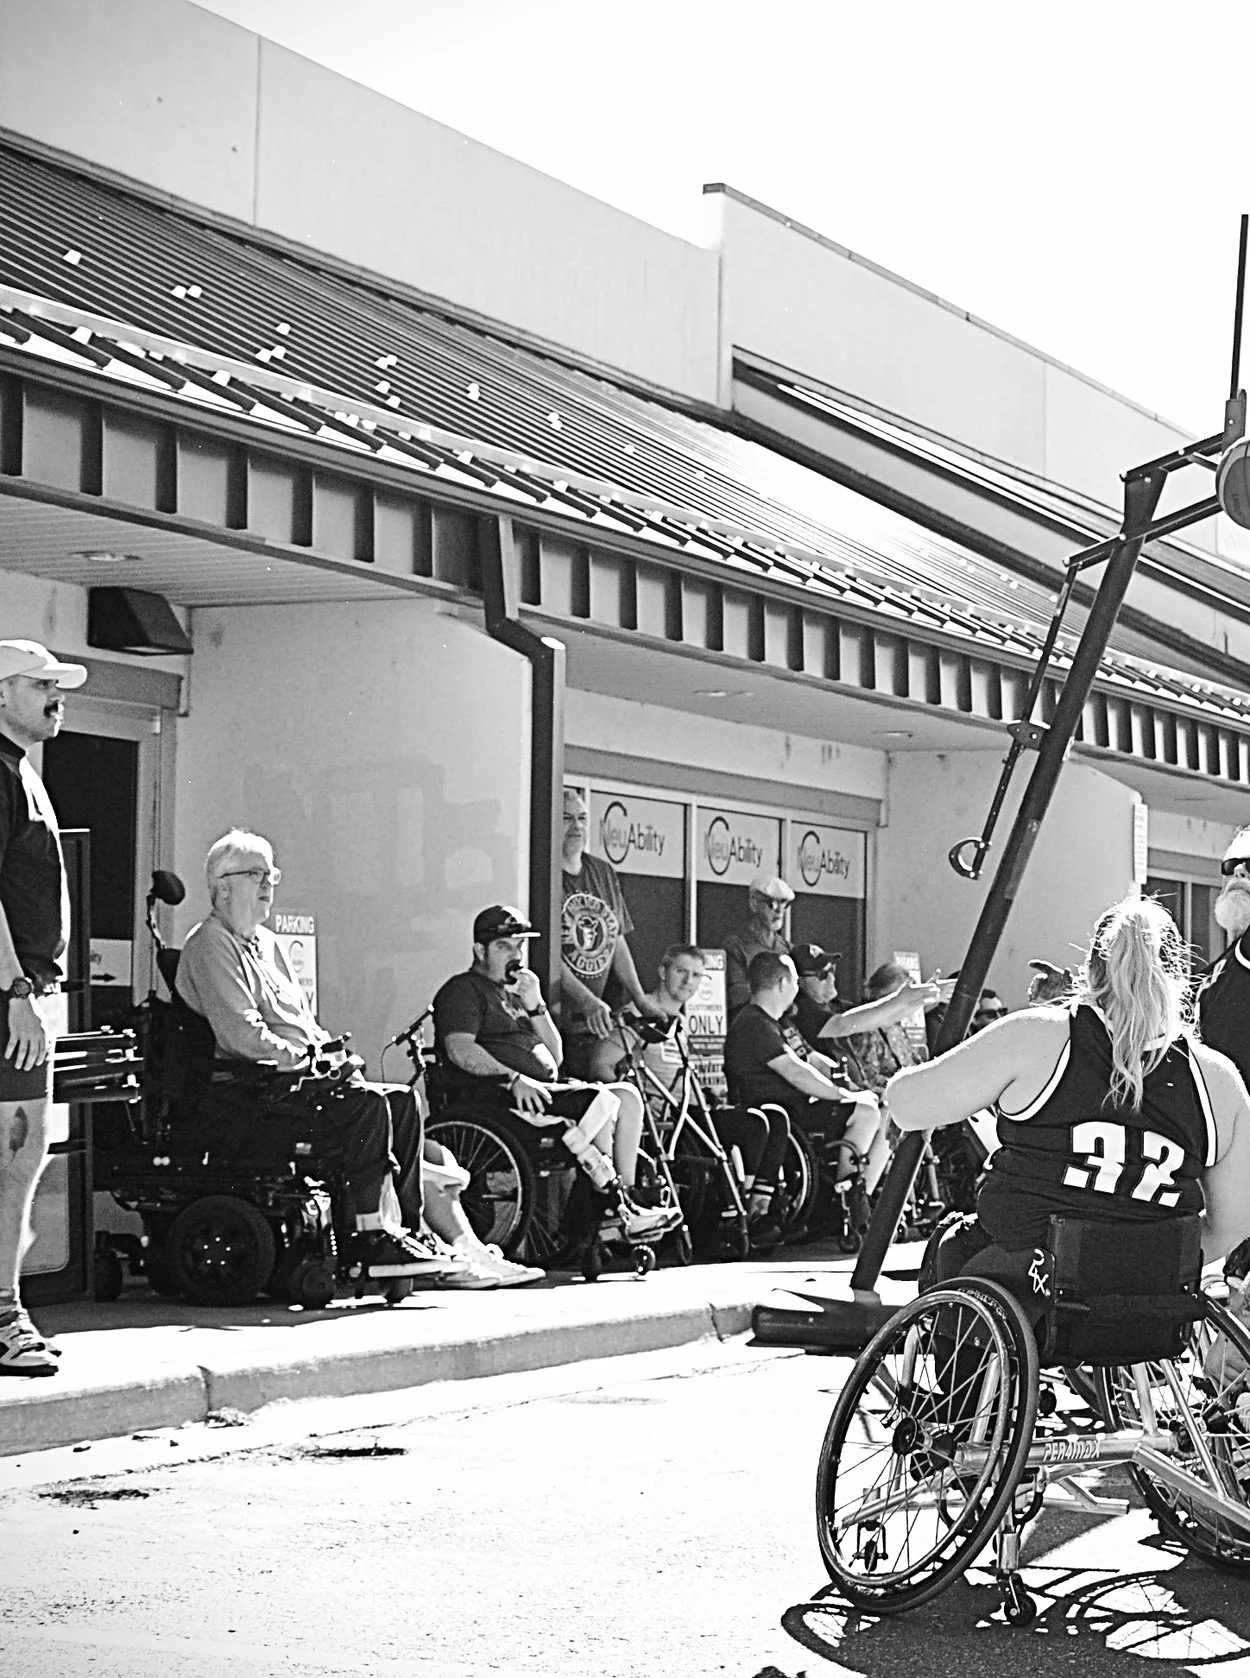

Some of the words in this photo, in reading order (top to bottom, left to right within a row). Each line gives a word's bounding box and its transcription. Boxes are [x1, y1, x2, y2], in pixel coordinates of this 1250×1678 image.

[275, 914, 315, 934] PARKING
[688, 1015, 724, 1035] ONLY
[1061, 1120, 1186, 1209] 32
